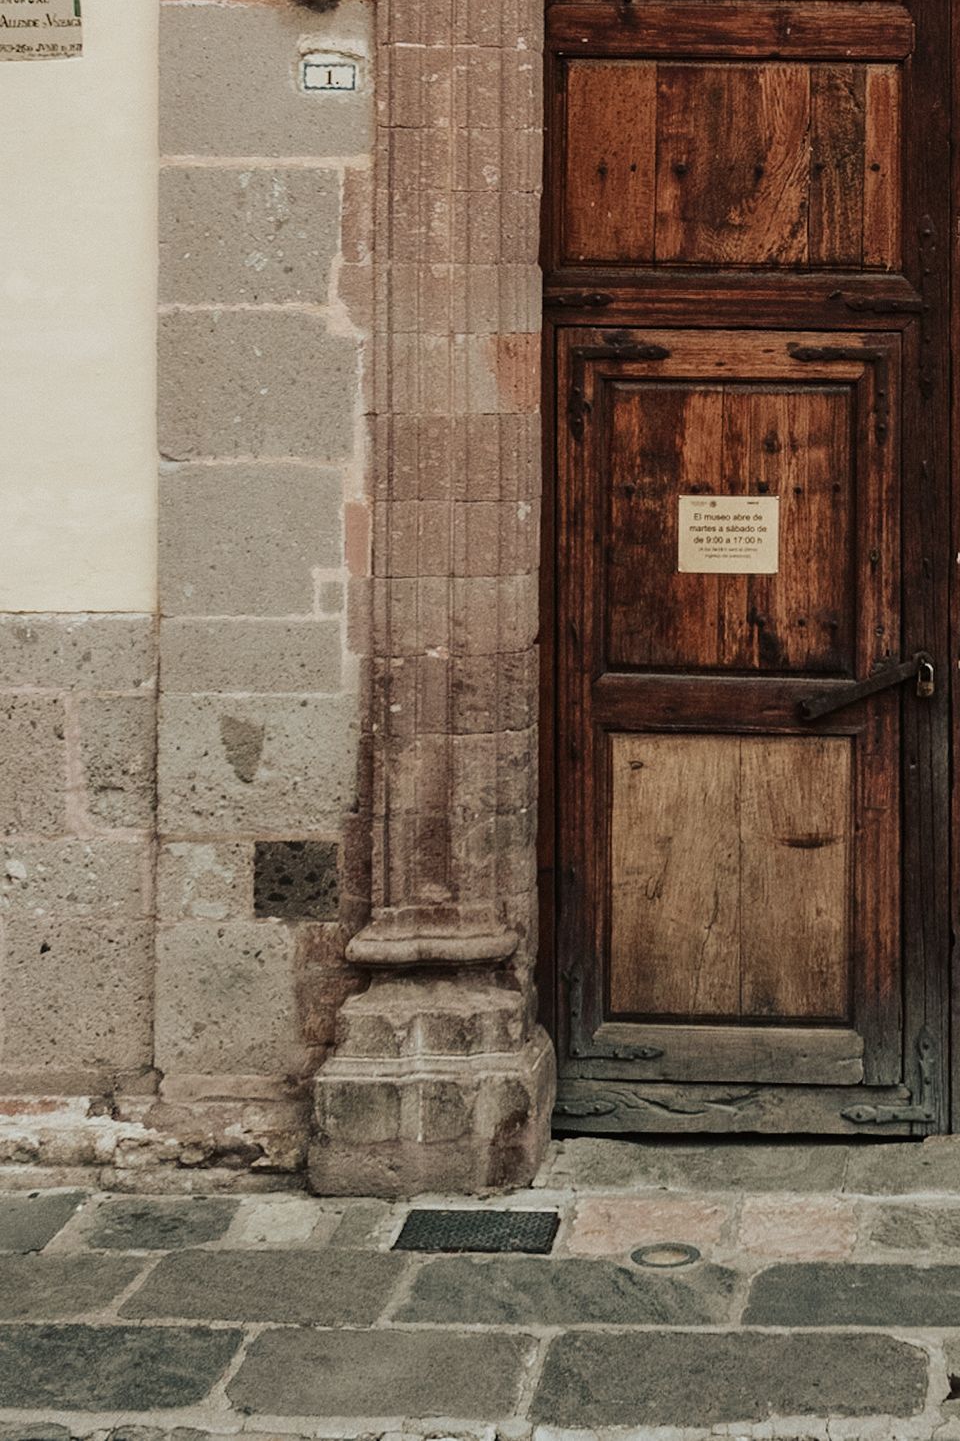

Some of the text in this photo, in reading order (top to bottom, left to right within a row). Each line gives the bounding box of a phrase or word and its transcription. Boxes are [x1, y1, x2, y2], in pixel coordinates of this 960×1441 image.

[693, 512, 702, 521] El
[733, 513, 751, 521] abre
[752, 513, 763, 521] de
[689, 525, 716, 533] martes
[725, 525, 756, 533] sábado
[757, 525, 767, 533] de
